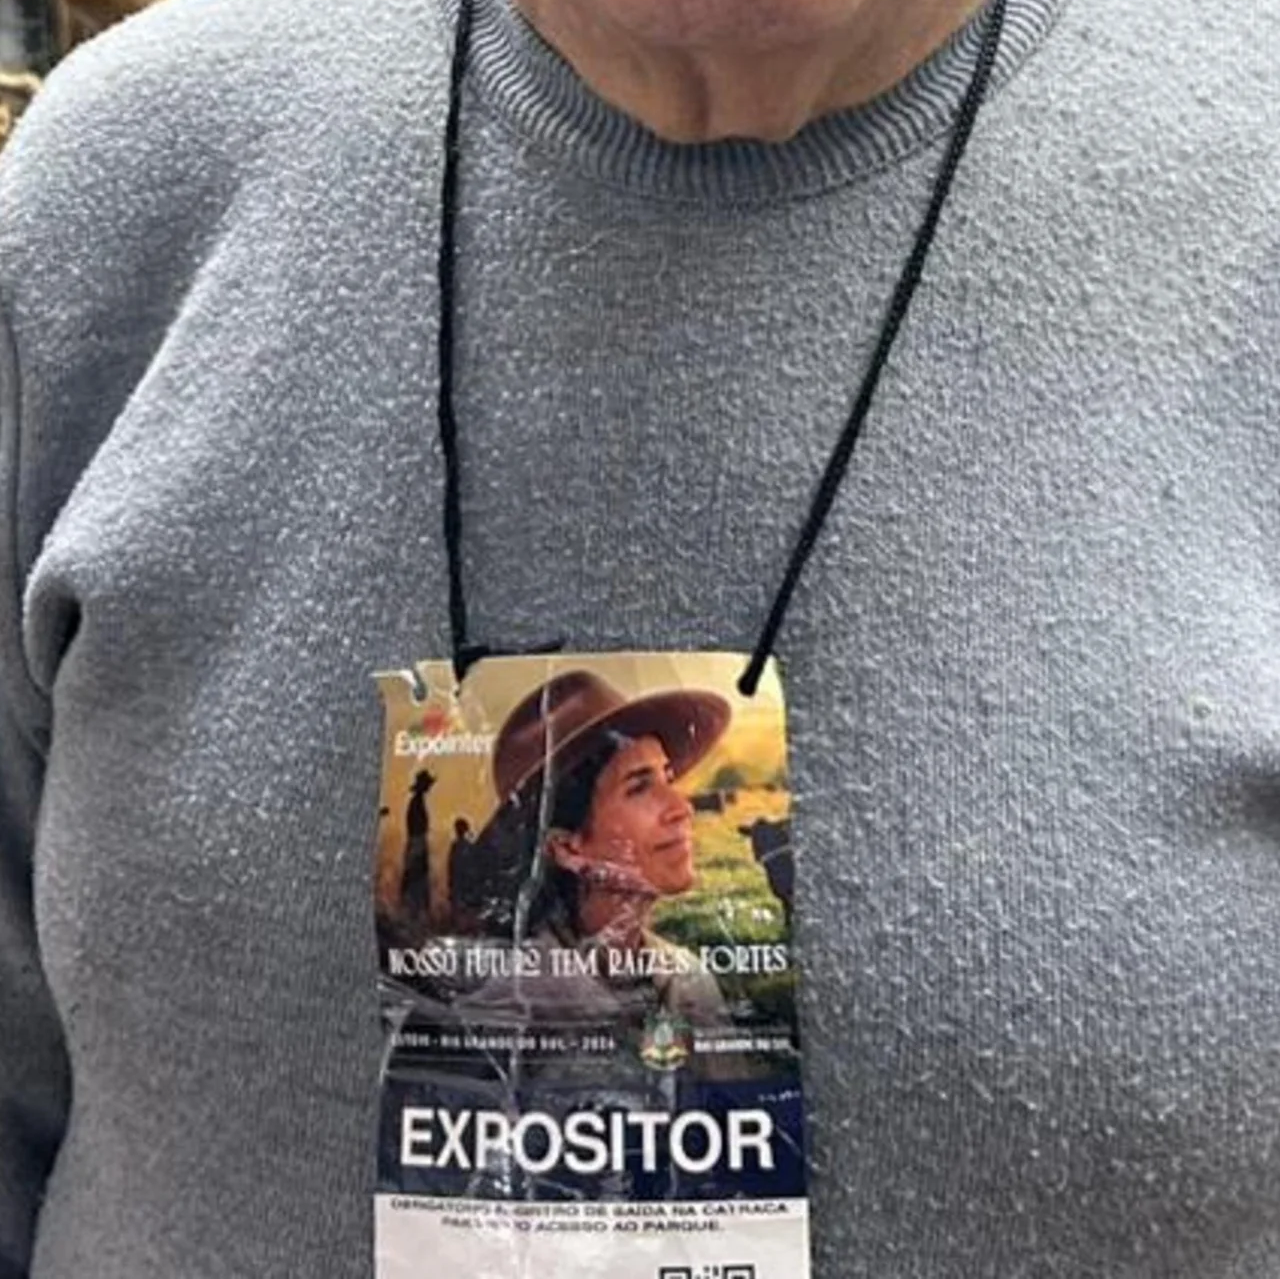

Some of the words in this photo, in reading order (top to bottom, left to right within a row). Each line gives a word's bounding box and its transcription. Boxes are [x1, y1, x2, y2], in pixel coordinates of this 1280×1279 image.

[388, 947, 457, 977] NOSSO
[549, 947, 599, 978] TEM
[699, 944, 788, 975] FORTES
[400, 1107, 775, 1174] EXPOSITOR
